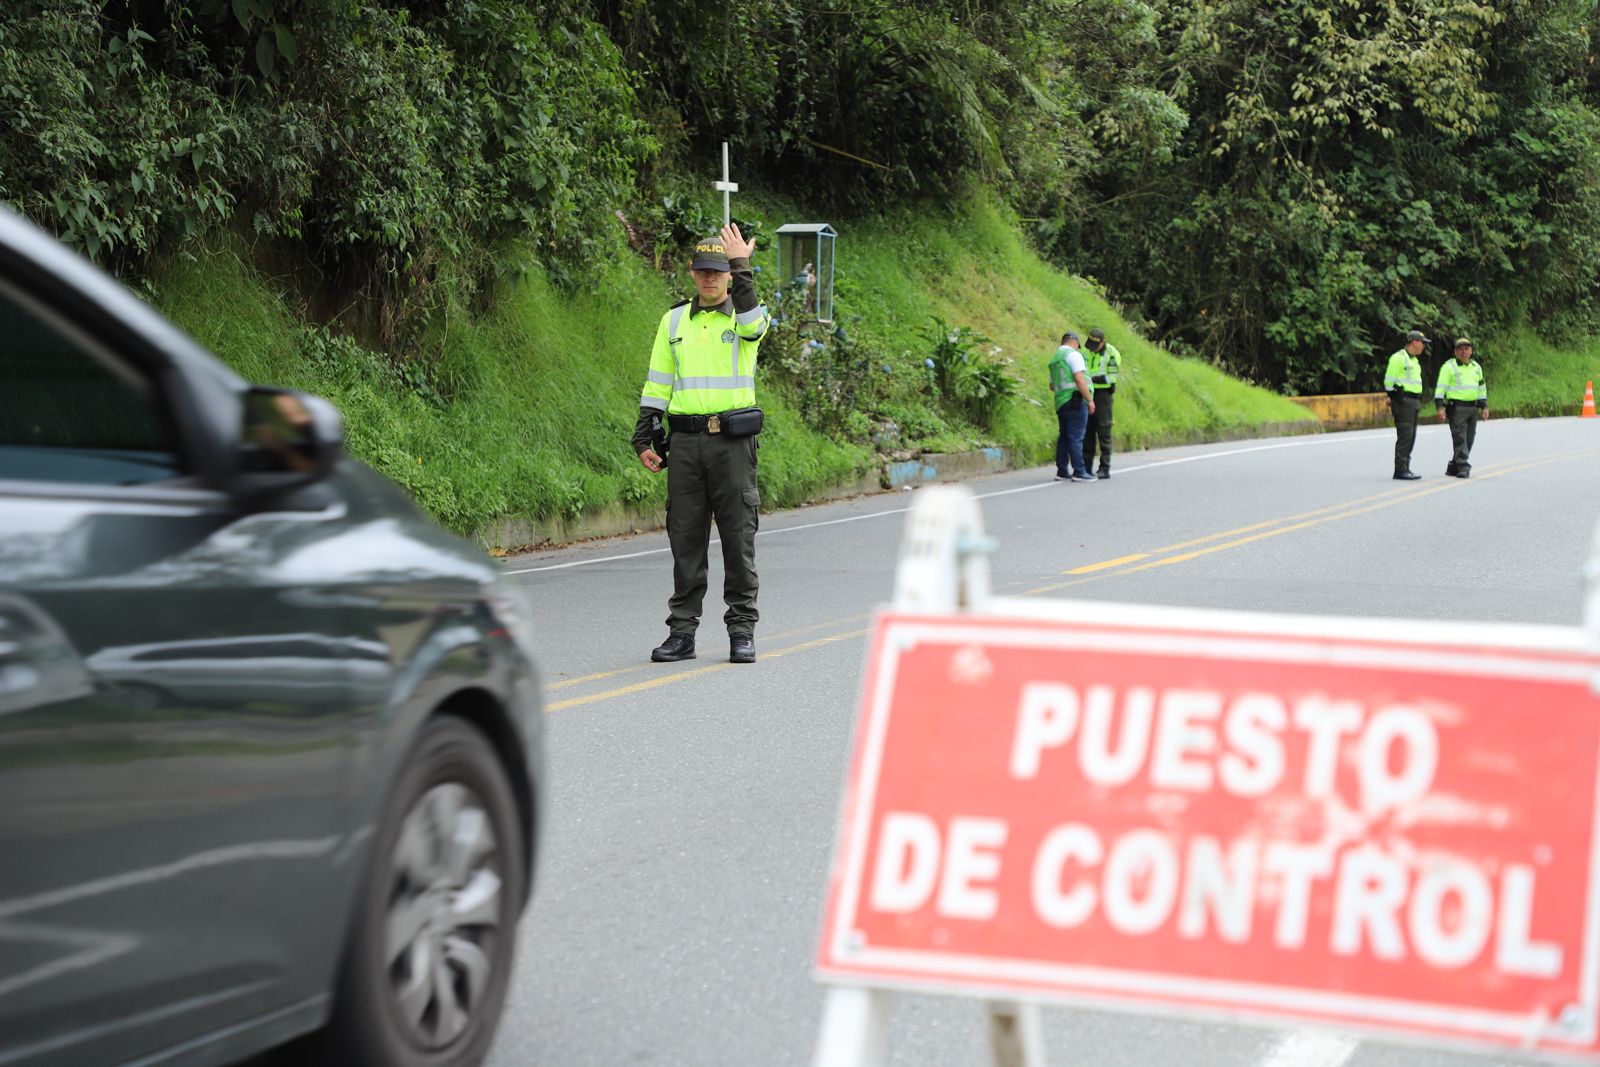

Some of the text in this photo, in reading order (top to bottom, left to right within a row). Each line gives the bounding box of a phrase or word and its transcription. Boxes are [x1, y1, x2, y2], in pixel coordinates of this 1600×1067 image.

[1010, 682, 1439, 809] PUESTO
[871, 812, 1562, 977] DE CONTROL
